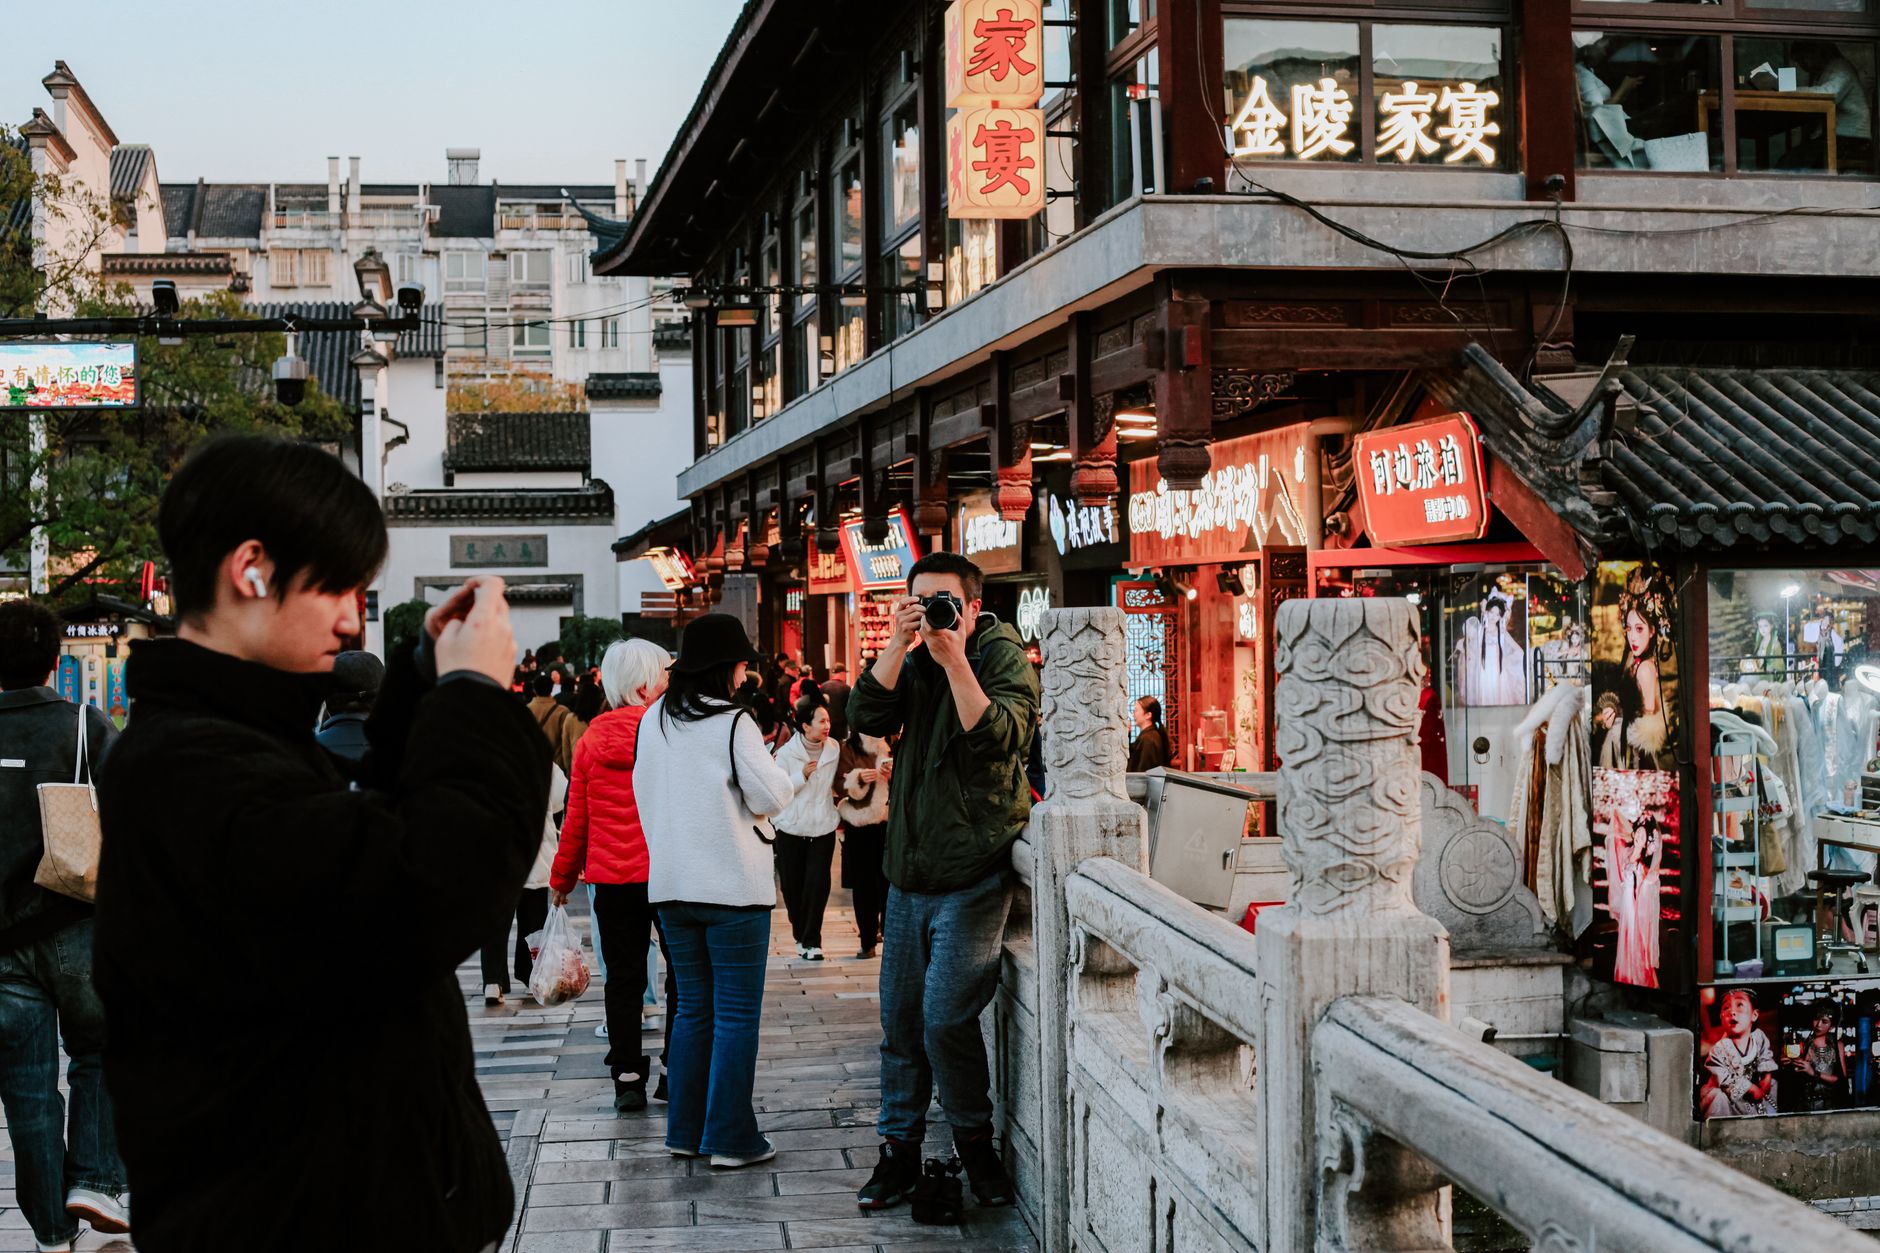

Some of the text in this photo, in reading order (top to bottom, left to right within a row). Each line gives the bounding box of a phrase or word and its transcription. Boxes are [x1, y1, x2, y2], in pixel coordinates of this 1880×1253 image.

[967, 8, 1036, 196] 家宴
[1231, 74, 1501, 166] 金陵家宴
[0, 364, 119, 387] 有情怀的您
